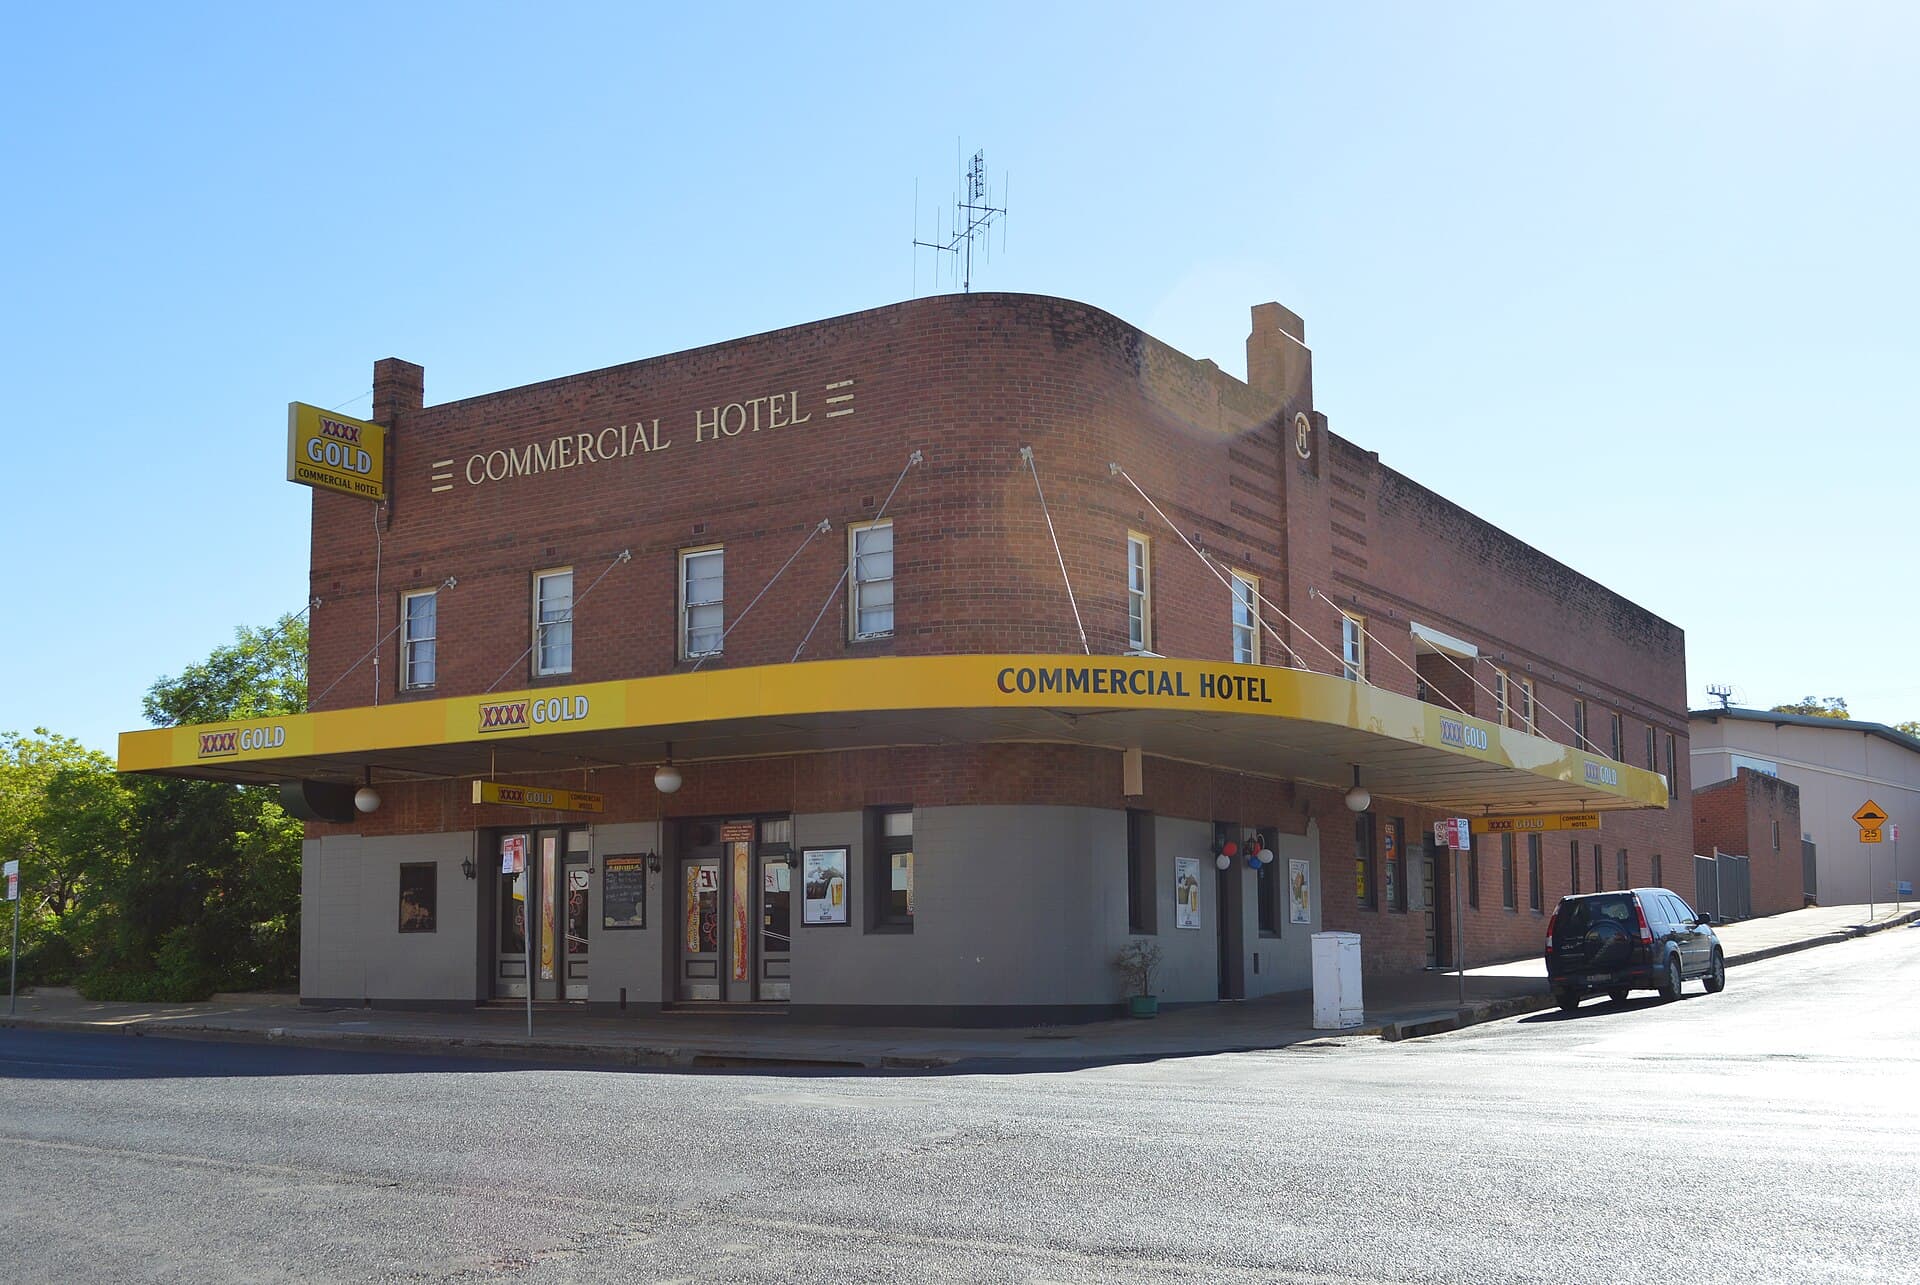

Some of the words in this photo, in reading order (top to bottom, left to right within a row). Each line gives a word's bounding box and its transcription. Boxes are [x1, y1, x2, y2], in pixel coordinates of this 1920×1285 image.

[322, 420, 359, 442] XXXX
[465, 419, 672, 487] COMMERCIAL
[694, 390, 812, 443] HOTEL
[307, 437, 372, 475] GOLD
[298, 467, 352, 490] COMMERCIAL
[354, 480, 379, 496] HOTEL
[997, 667, 1190, 697] COMMERCIAL
[1200, 673, 1273, 703] HOTEL
[483, 703, 526, 728] XXXX
[532, 695, 590, 724] GOLD
[201, 731, 236, 753] XXXX
[239, 725, 286, 751] GOLD
[1442, 719, 1462, 744] XXXX
[1464, 725, 1488, 751] GOLD
[1584, 763, 1600, 781] XXXX
[1600, 766, 1617, 786] GOLD
[500, 789, 522, 801] XXXX
[525, 791, 553, 804] GOLD
[1458, 820, 1468, 829] 2P
[1489, 820, 1513, 830] XXXX
[1516, 820, 1544, 829] GOLD
[1561, 814, 1596, 822] COMMERCIAL
